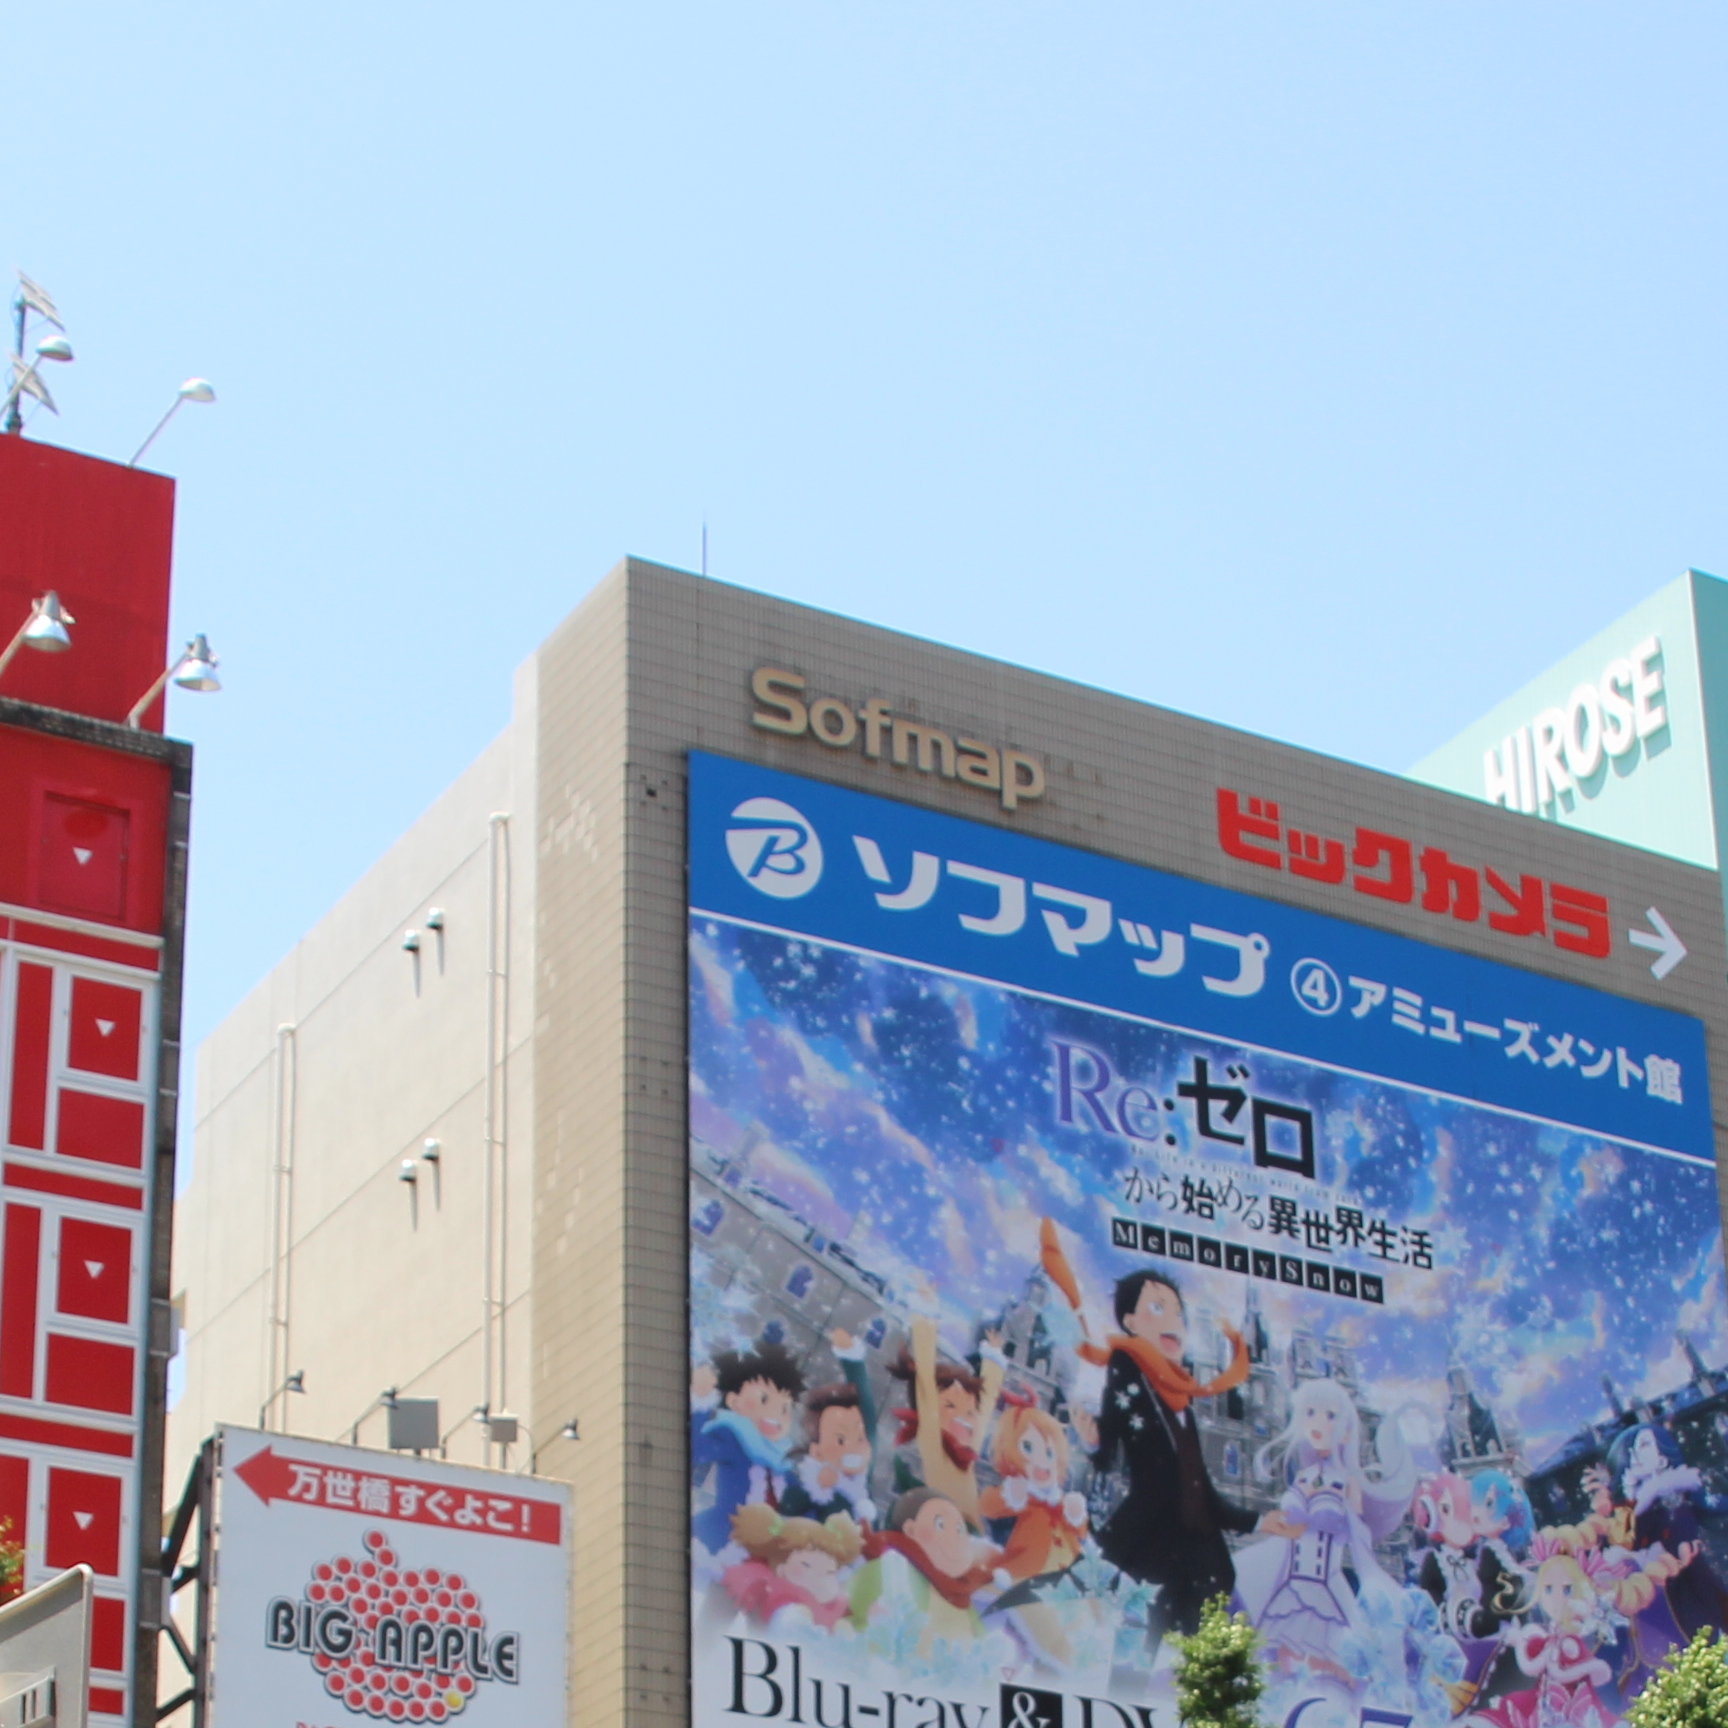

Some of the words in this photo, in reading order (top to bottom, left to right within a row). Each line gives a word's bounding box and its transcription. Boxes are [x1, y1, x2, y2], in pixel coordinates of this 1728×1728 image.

[749, 666, 1047, 811] Sofmap
[1483, 635, 1670, 815] HIROSE
[852, 832, 1272, 998] ソフマップ
[1214, 787, 1612, 961] ビックカメラ
[1124, 1166, 1435, 1271] から始める異世界生活
[266, 1596, 359, 1659] BIG
[375, 1615, 520, 1684] APPLE
